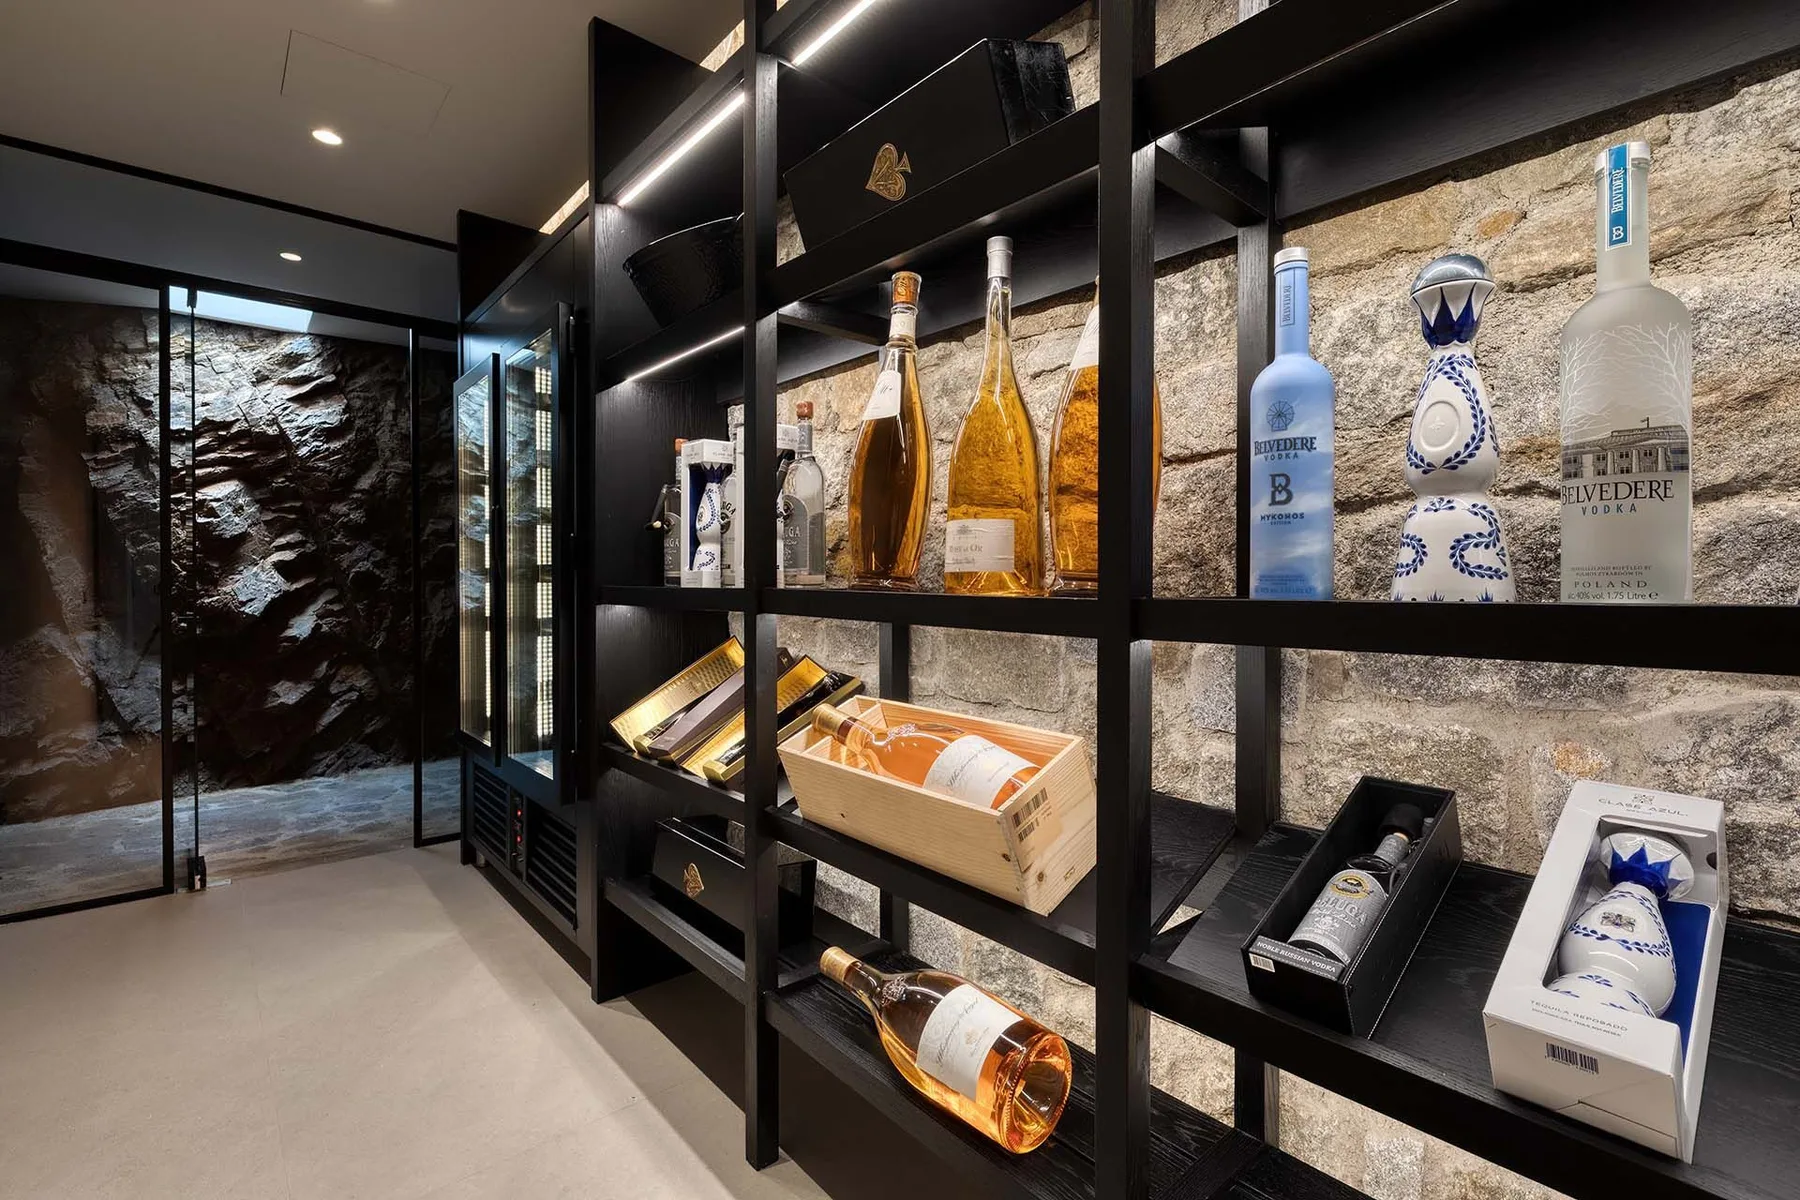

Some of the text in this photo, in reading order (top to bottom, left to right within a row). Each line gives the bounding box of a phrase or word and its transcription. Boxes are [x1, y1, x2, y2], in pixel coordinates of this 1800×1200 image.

[1611, 167, 1625, 214] BELVEDERE
[1254, 436, 1317, 456] BELVEDERE
[1264, 452, 1299, 461] VODKA
[1561, 479, 1674, 505] BELVEDERE
[1581, 503, 1637, 516] VODKA
[1260, 512, 1305, 522] MYKONOS
[1574, 580, 1648, 589] POLAND
[1607, 591, 1624, 600] 1.75
[1627, 591, 1647, 600] Litre
[1598, 798, 1641, 810] CLASE
[1256, 941, 1337, 973] NOBLE RUSSIAN VODKA
[1530, 1000, 1570, 1014] TEQUILA
[1573, 1013, 1628, 1032] REPOSADO
